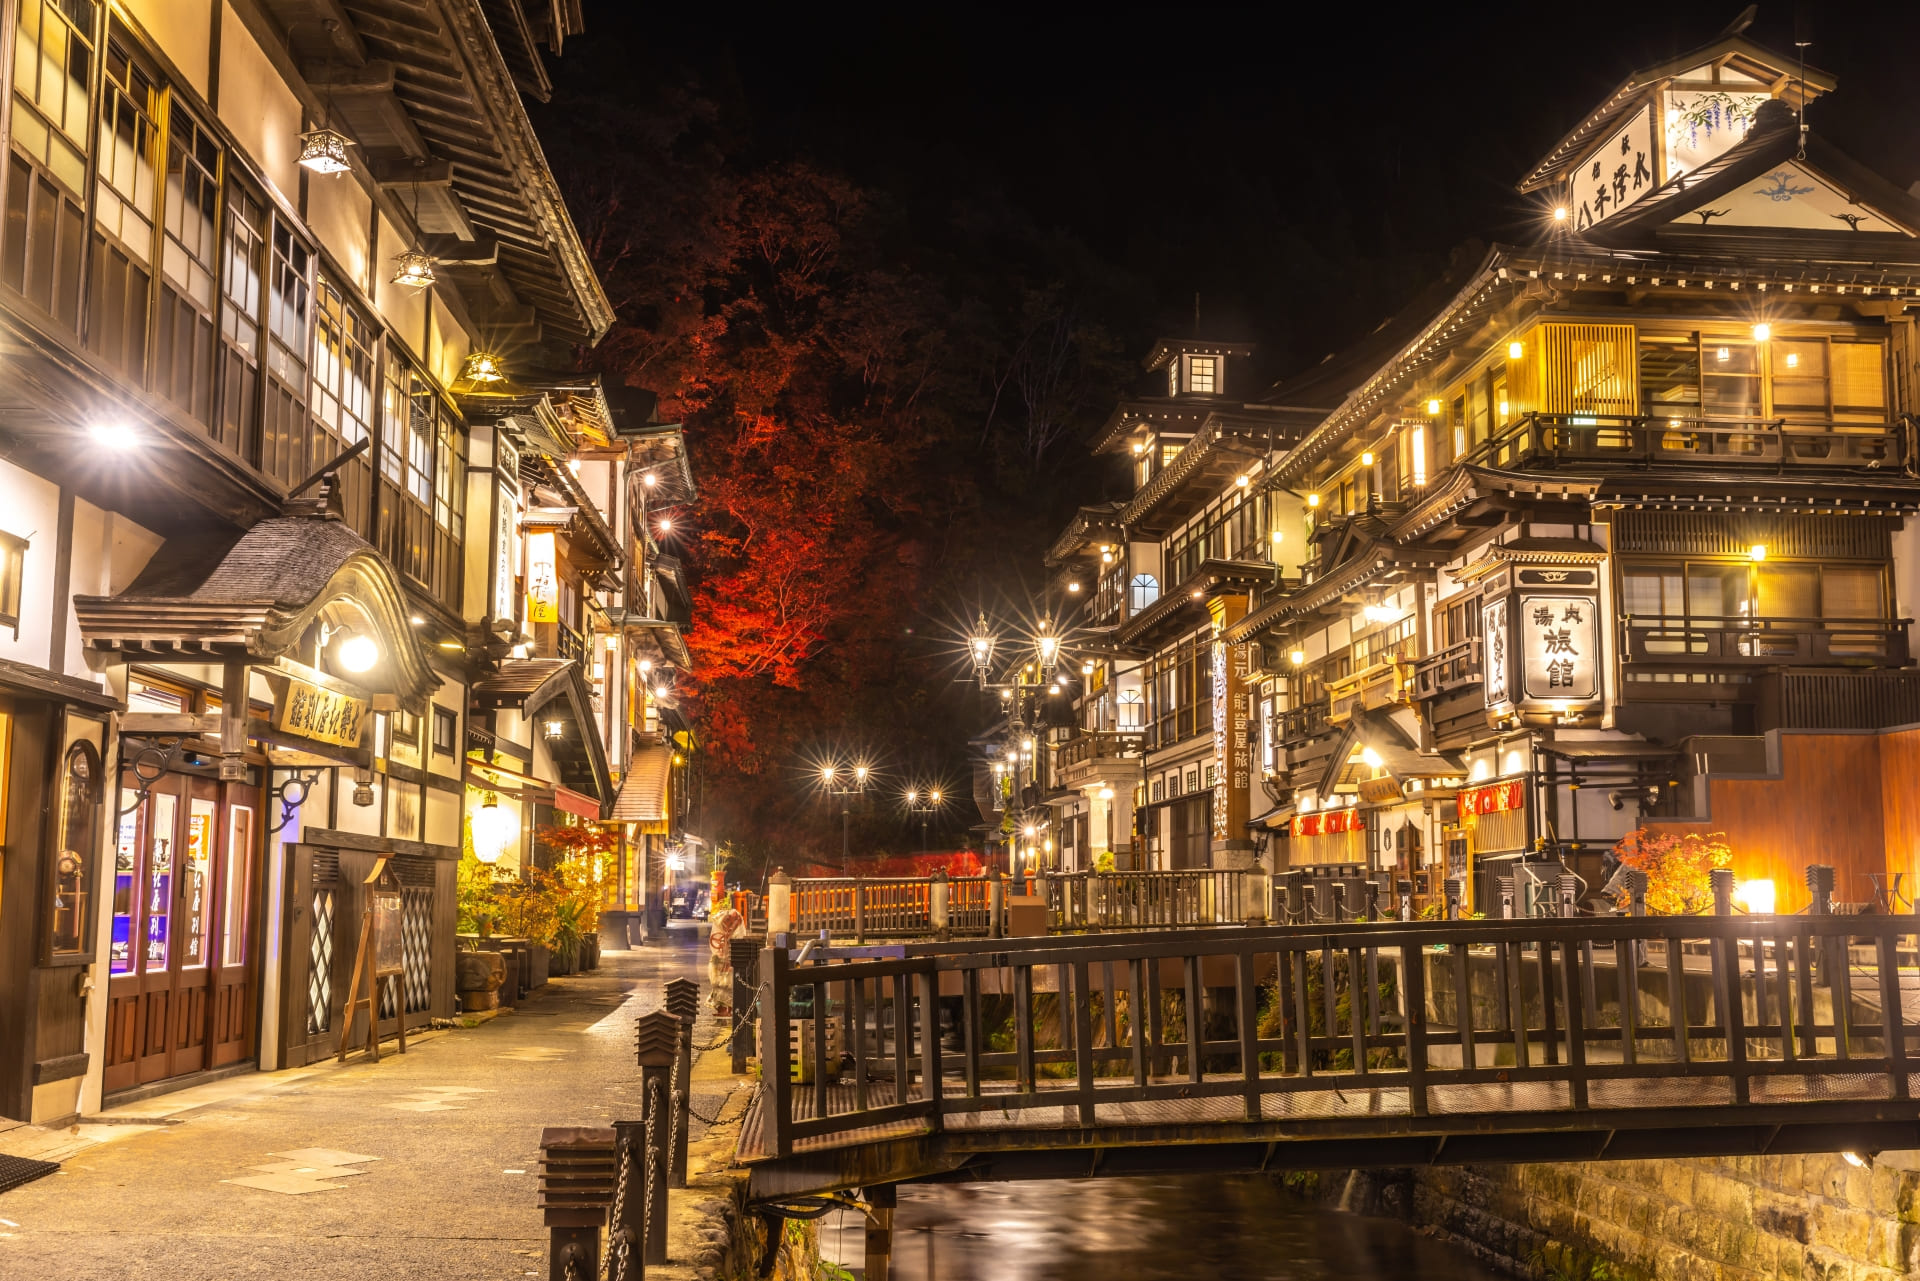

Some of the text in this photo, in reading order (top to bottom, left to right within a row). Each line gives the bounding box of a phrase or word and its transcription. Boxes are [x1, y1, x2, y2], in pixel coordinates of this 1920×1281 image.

[1533, 603, 1584, 627] 内湯
[1544, 627, 1579, 689] 旅館
[1234, 645, 1248, 790] 湯元 能登屋旅館
